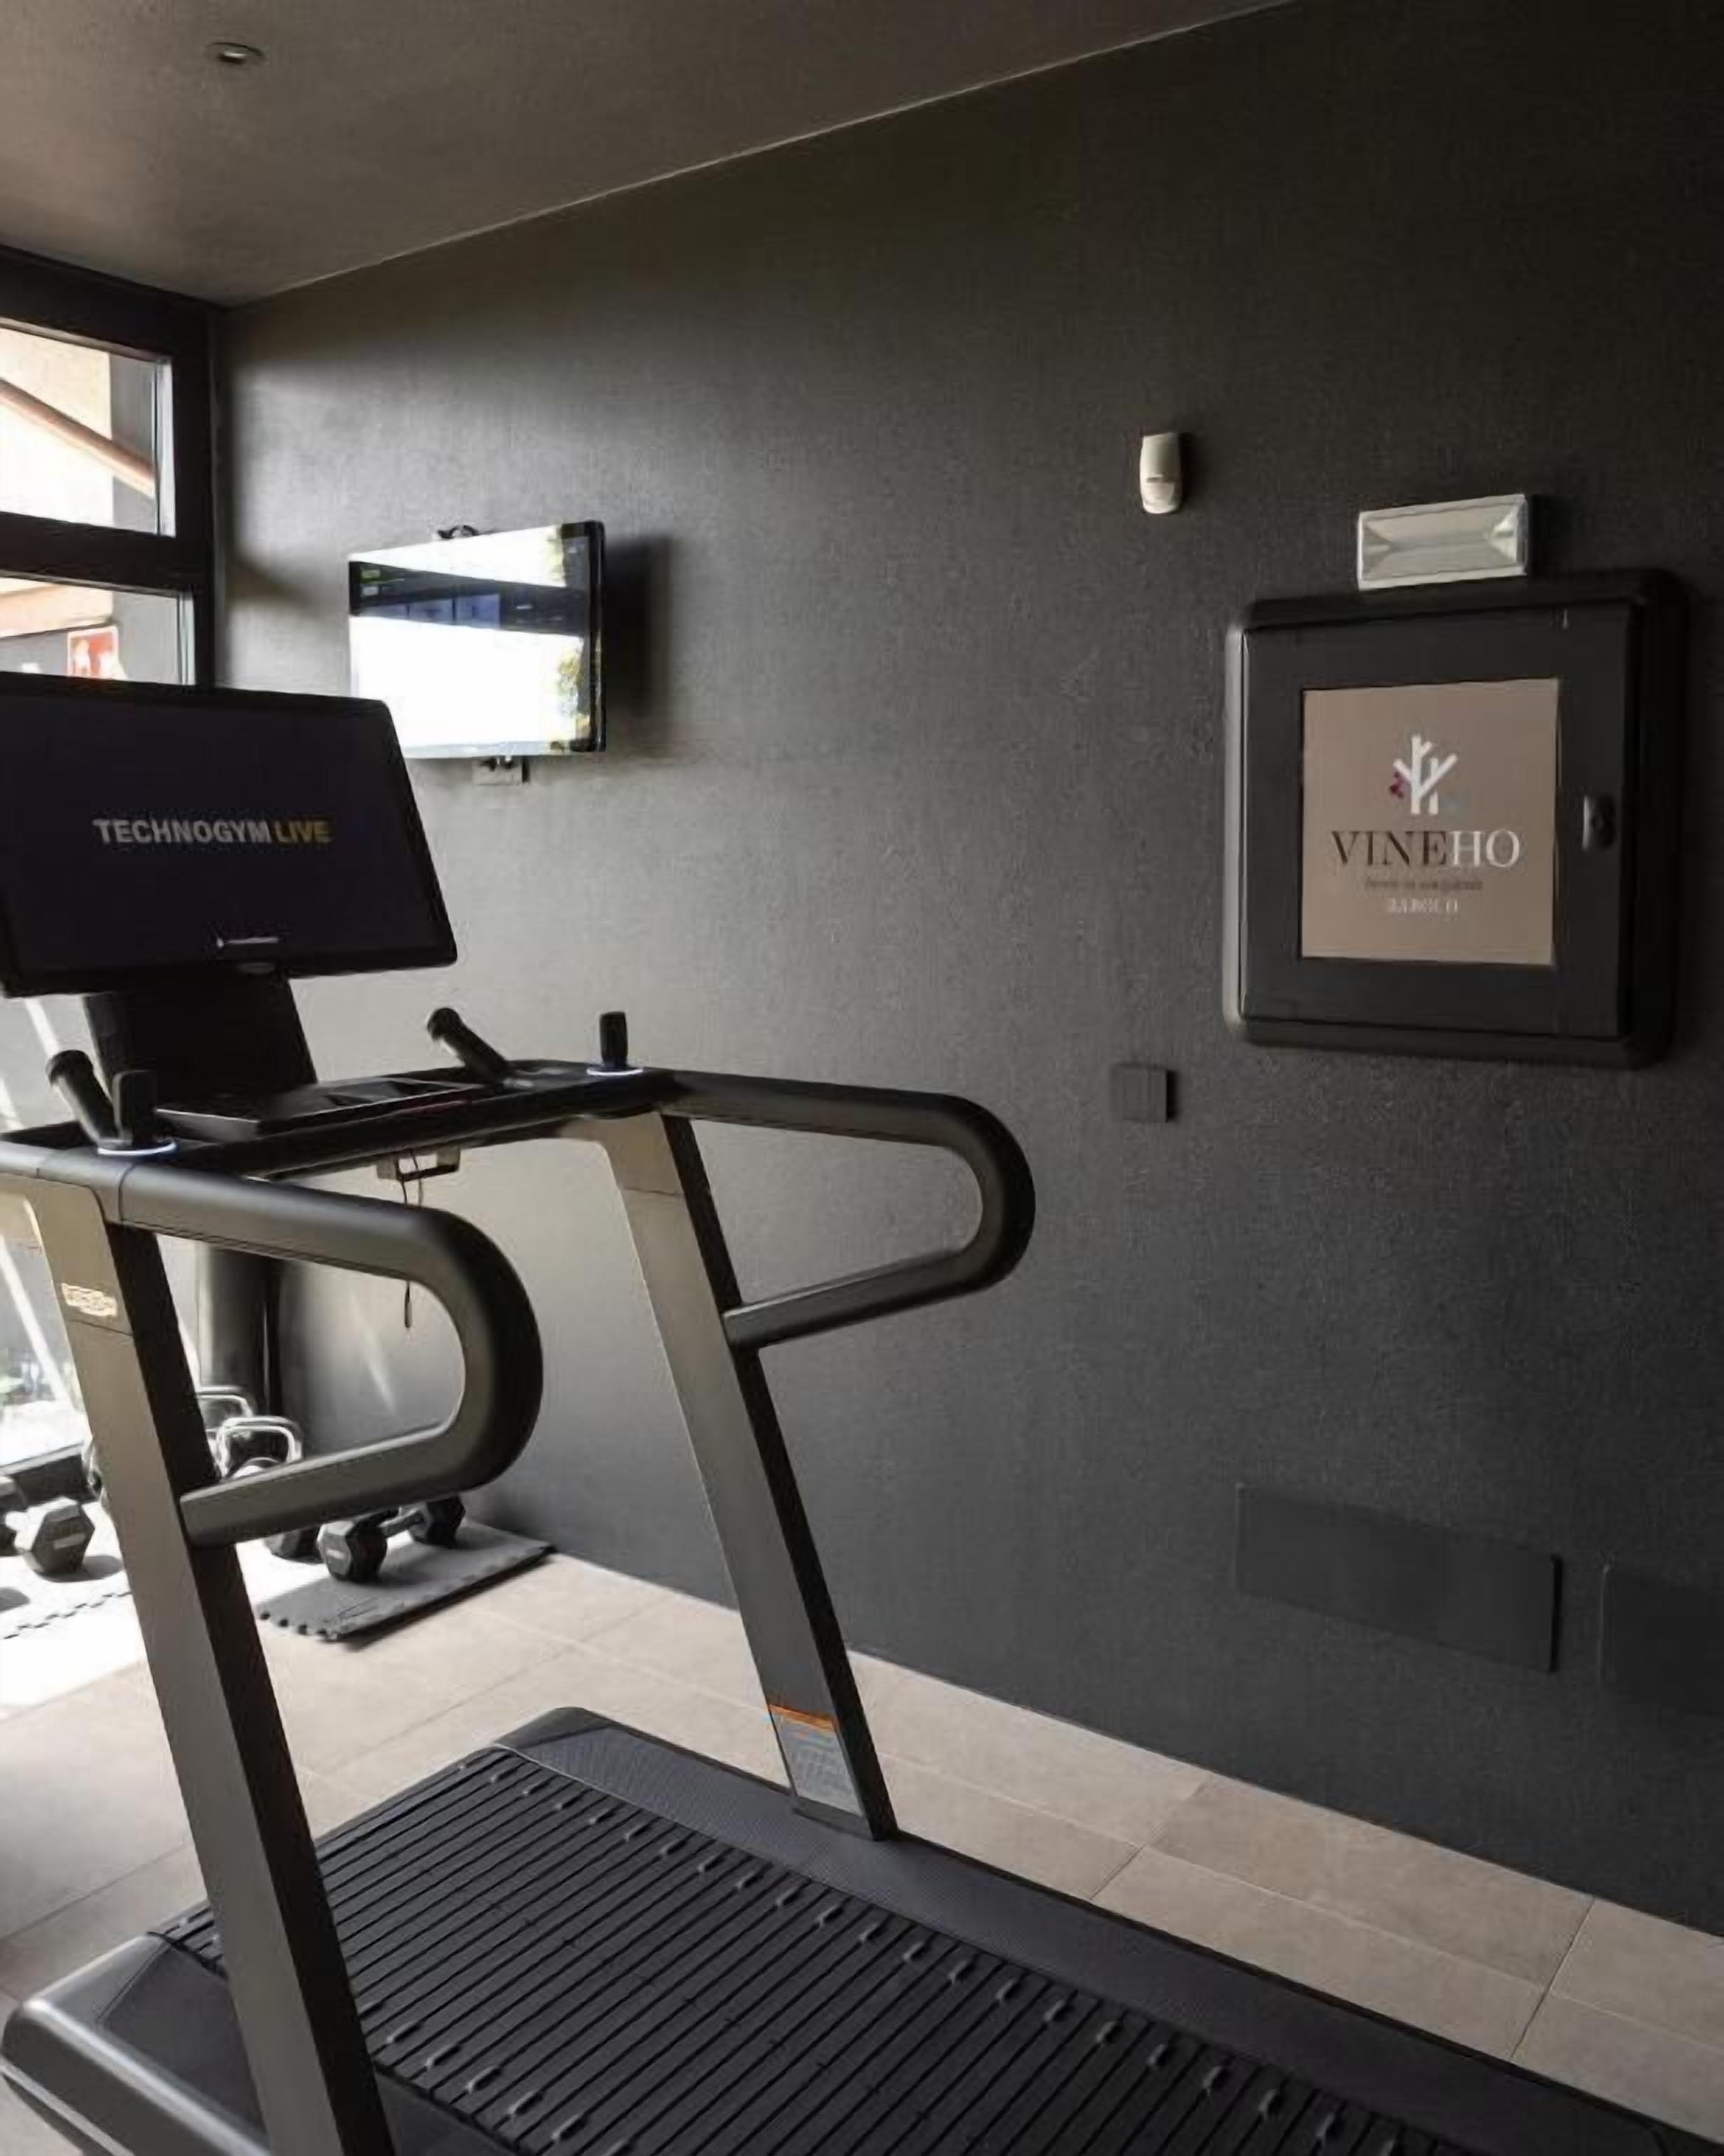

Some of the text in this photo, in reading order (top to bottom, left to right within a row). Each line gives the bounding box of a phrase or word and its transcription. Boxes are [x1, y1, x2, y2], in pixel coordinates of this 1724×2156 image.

[93, 818, 331, 844] TECHNOGYM LIVE
[1331, 829, 1520, 867] VINEHO
